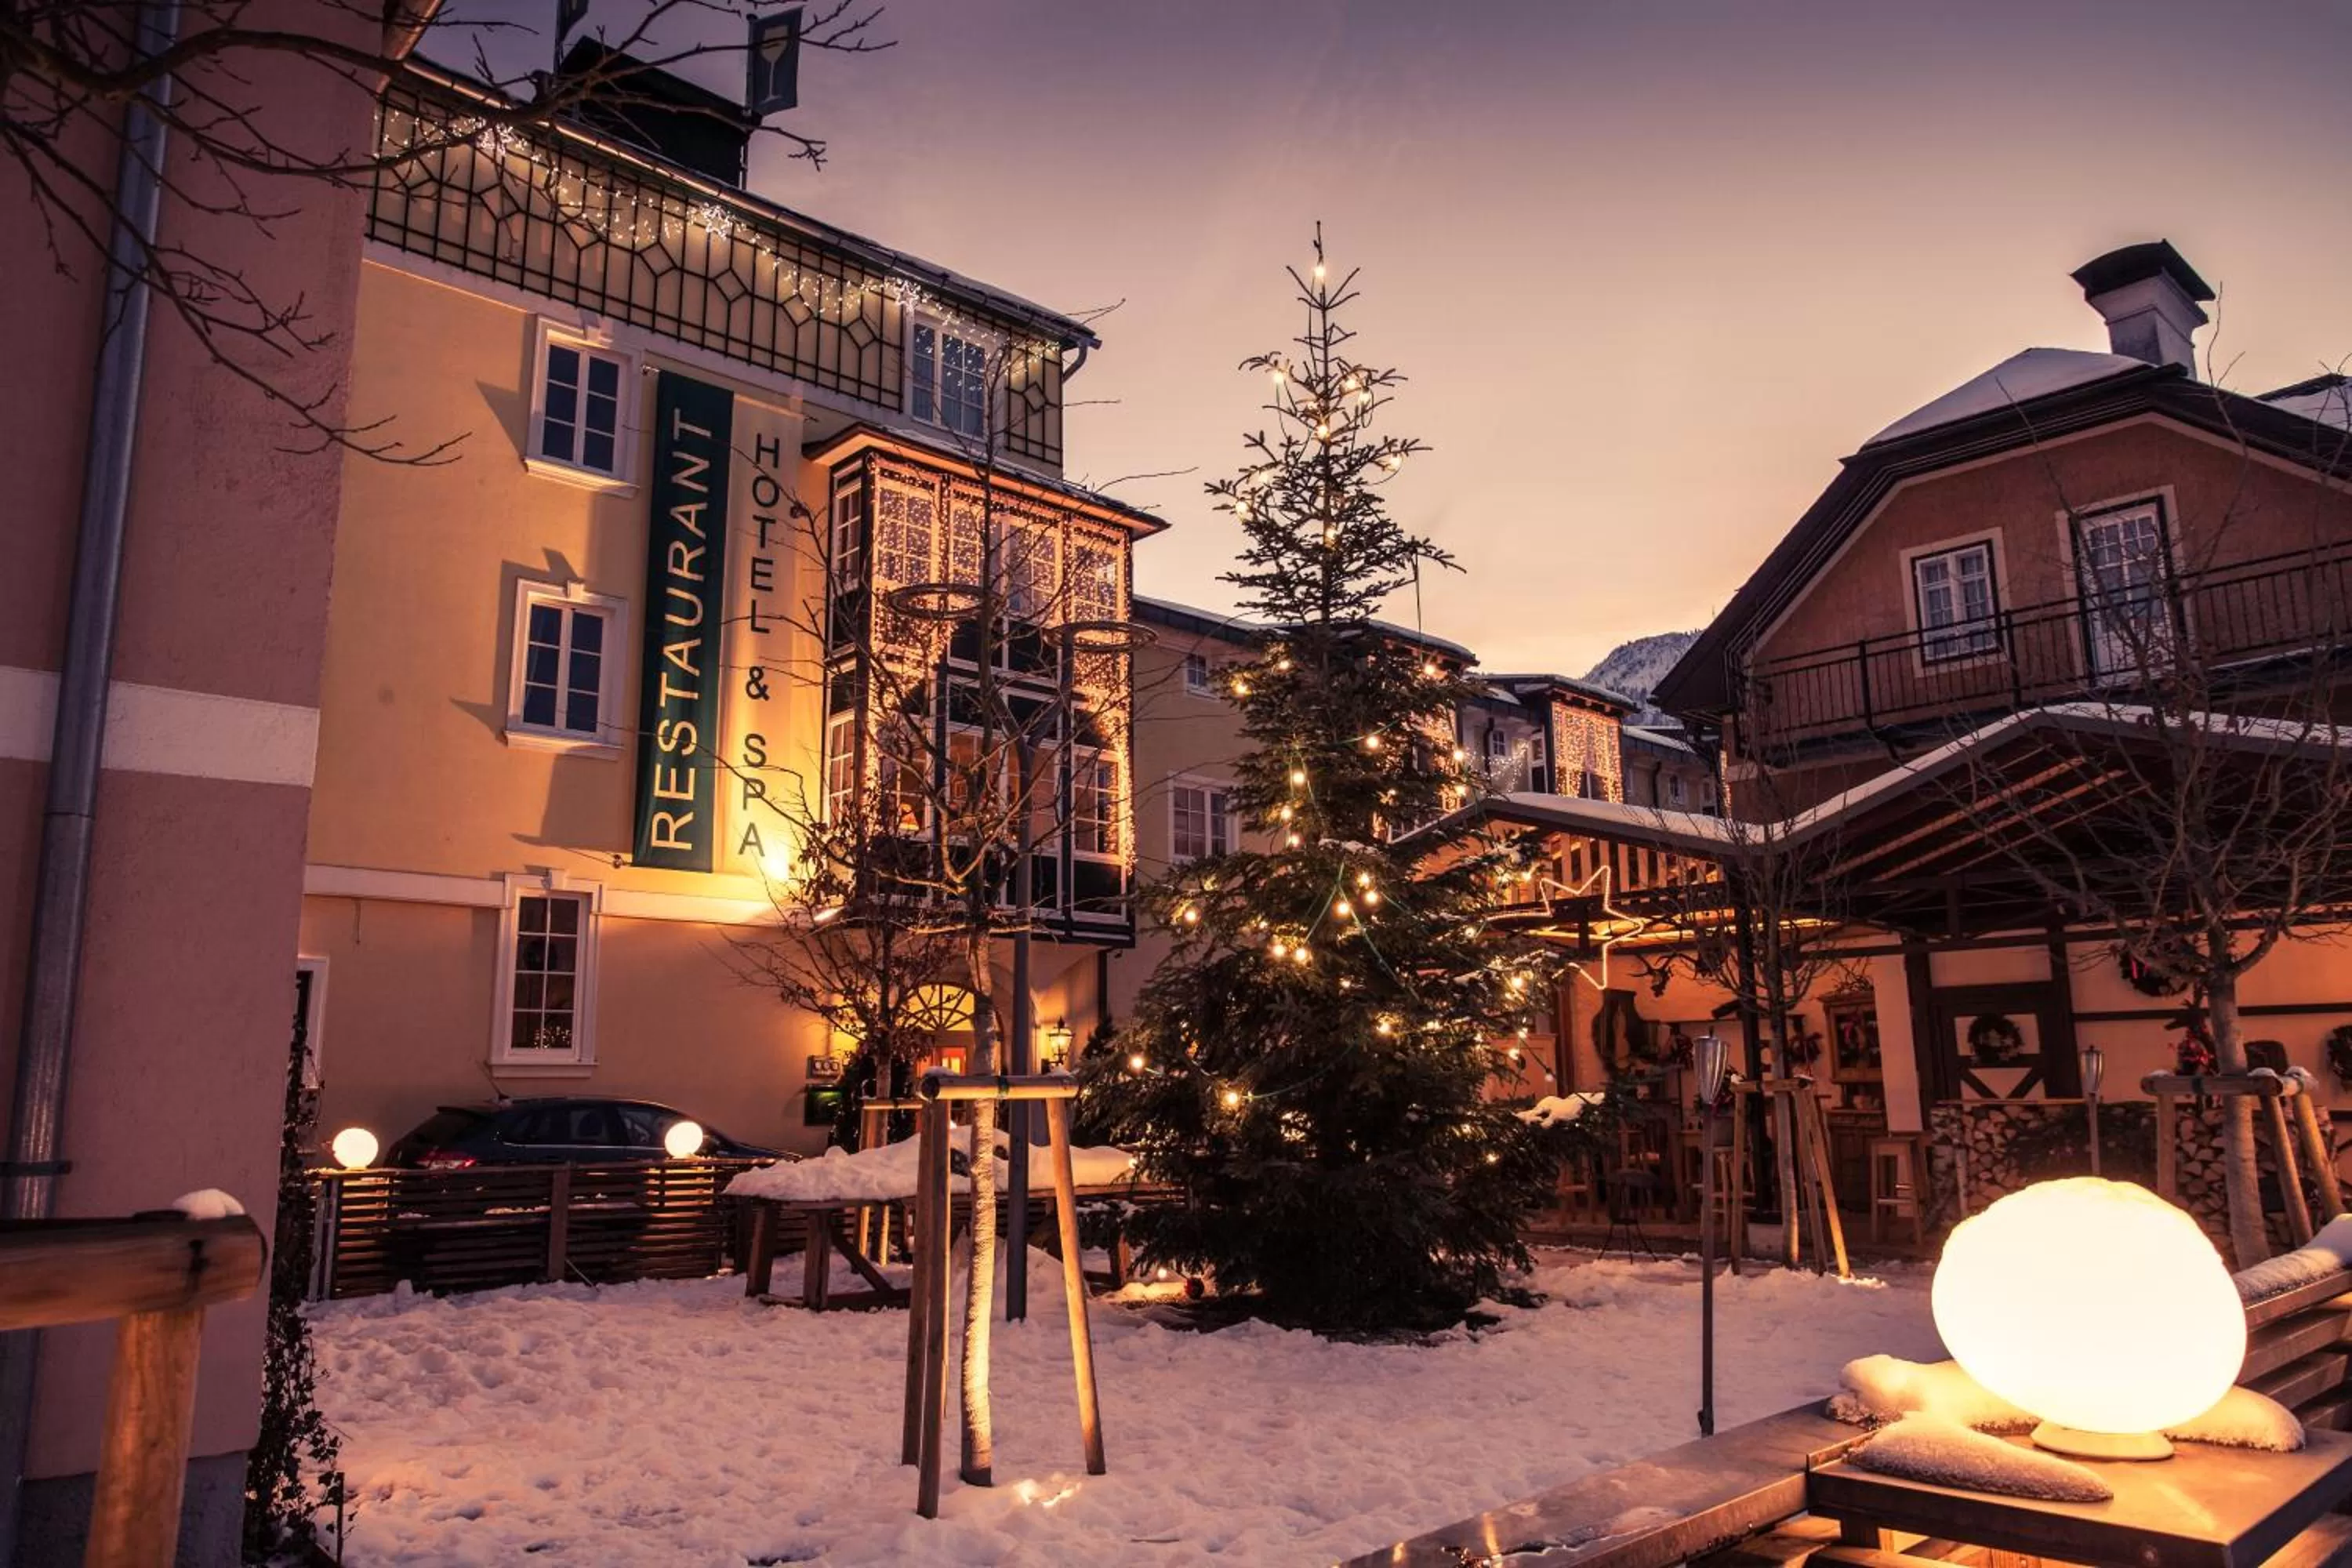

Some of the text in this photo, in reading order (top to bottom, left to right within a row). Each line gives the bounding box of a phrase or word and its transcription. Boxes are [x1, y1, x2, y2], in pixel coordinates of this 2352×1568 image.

[652, 408, 713, 850] RESTAURANT
[738, 432, 780, 858] HOTEL & SPA
